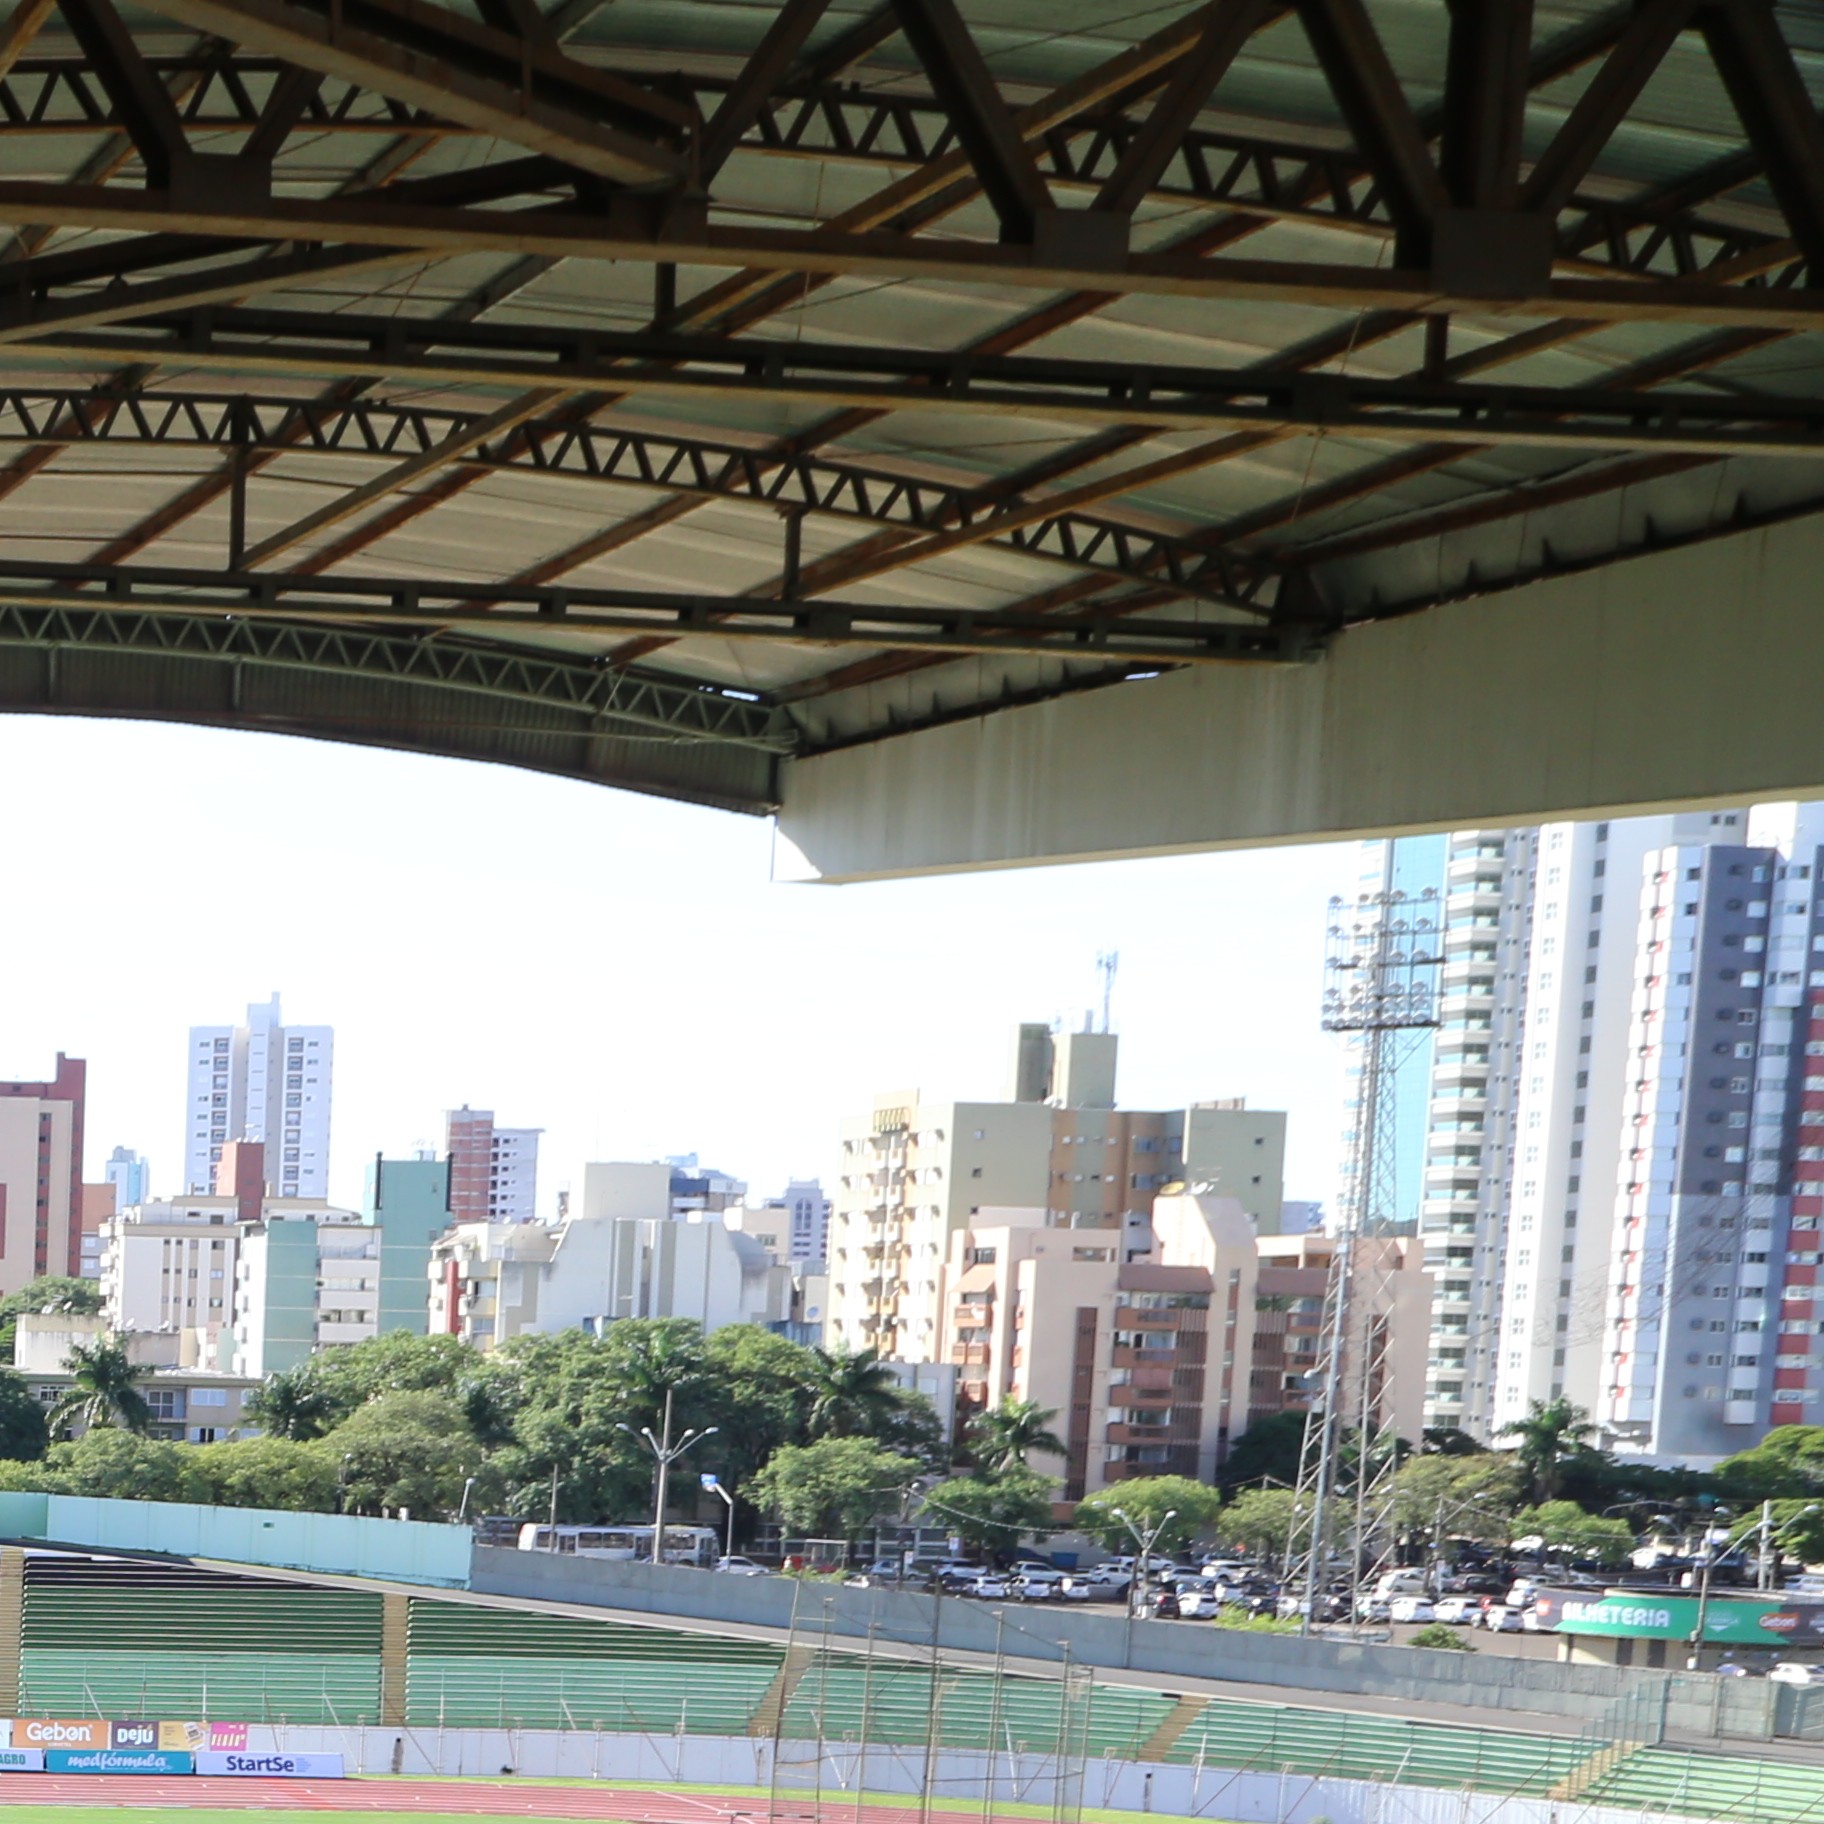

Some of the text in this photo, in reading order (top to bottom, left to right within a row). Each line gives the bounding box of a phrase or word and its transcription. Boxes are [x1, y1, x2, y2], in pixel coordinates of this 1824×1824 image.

[1561, 1601, 1670, 1628] BILHETERIA
[26, 1722, 91, 1742] Gebon
[67, 1751, 167, 1772] medfórmula
[226, 1755, 295, 1773] StartSe
